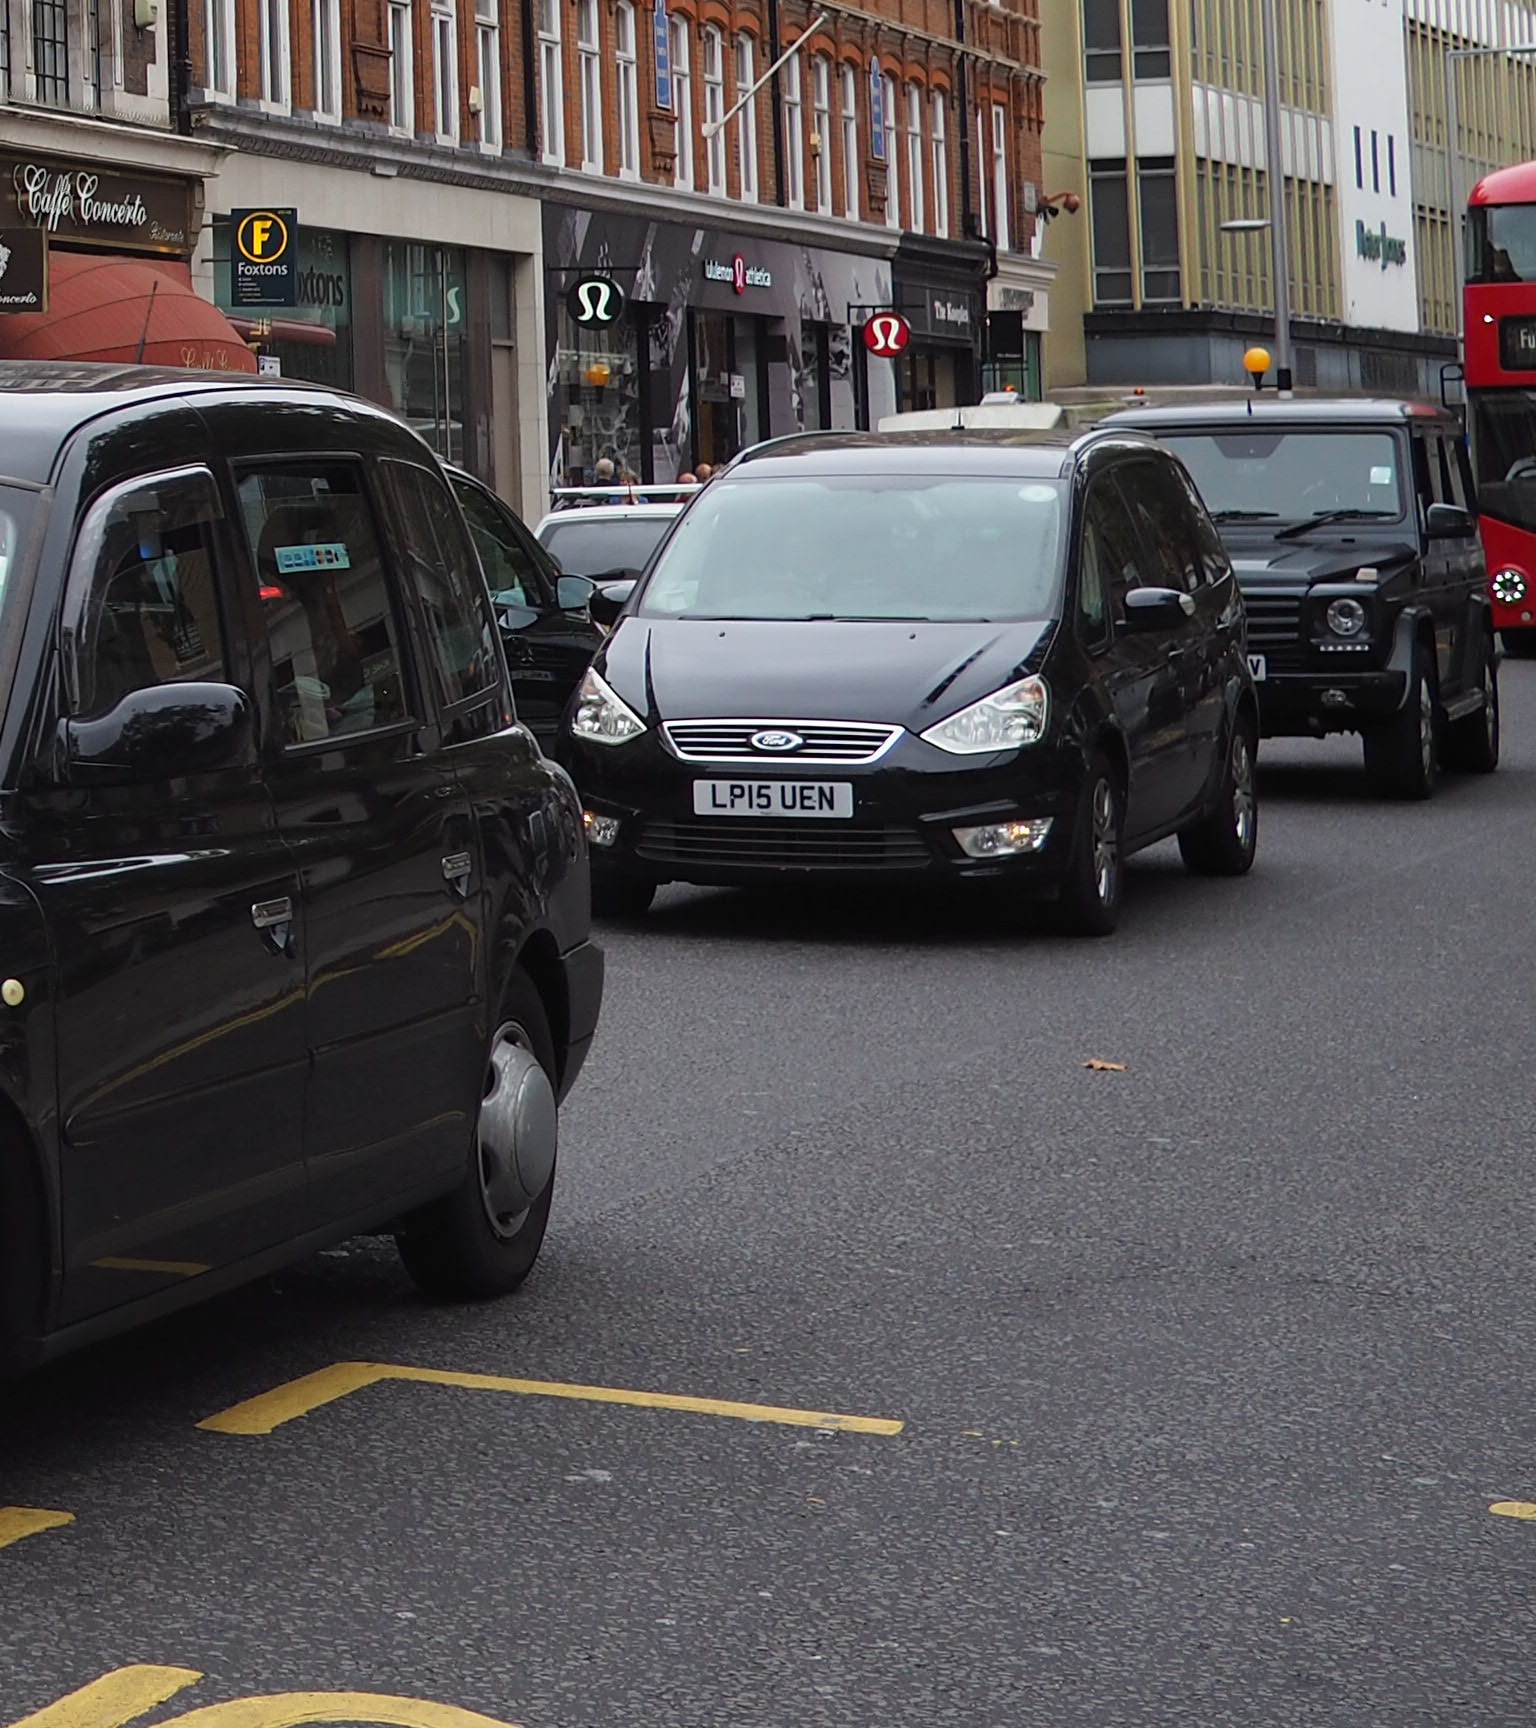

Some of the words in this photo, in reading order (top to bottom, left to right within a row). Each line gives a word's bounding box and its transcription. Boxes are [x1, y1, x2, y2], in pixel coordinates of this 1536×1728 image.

[76, 172, 148, 227] Concerto
[252, 219, 273, 256] F
[237, 262, 288, 276] Foxtons
[296, 264, 344, 307] xtons
[761, 734, 788, 747] Ford
[711, 783, 772, 810] LP15
[780, 784, 835, 811] UEN
